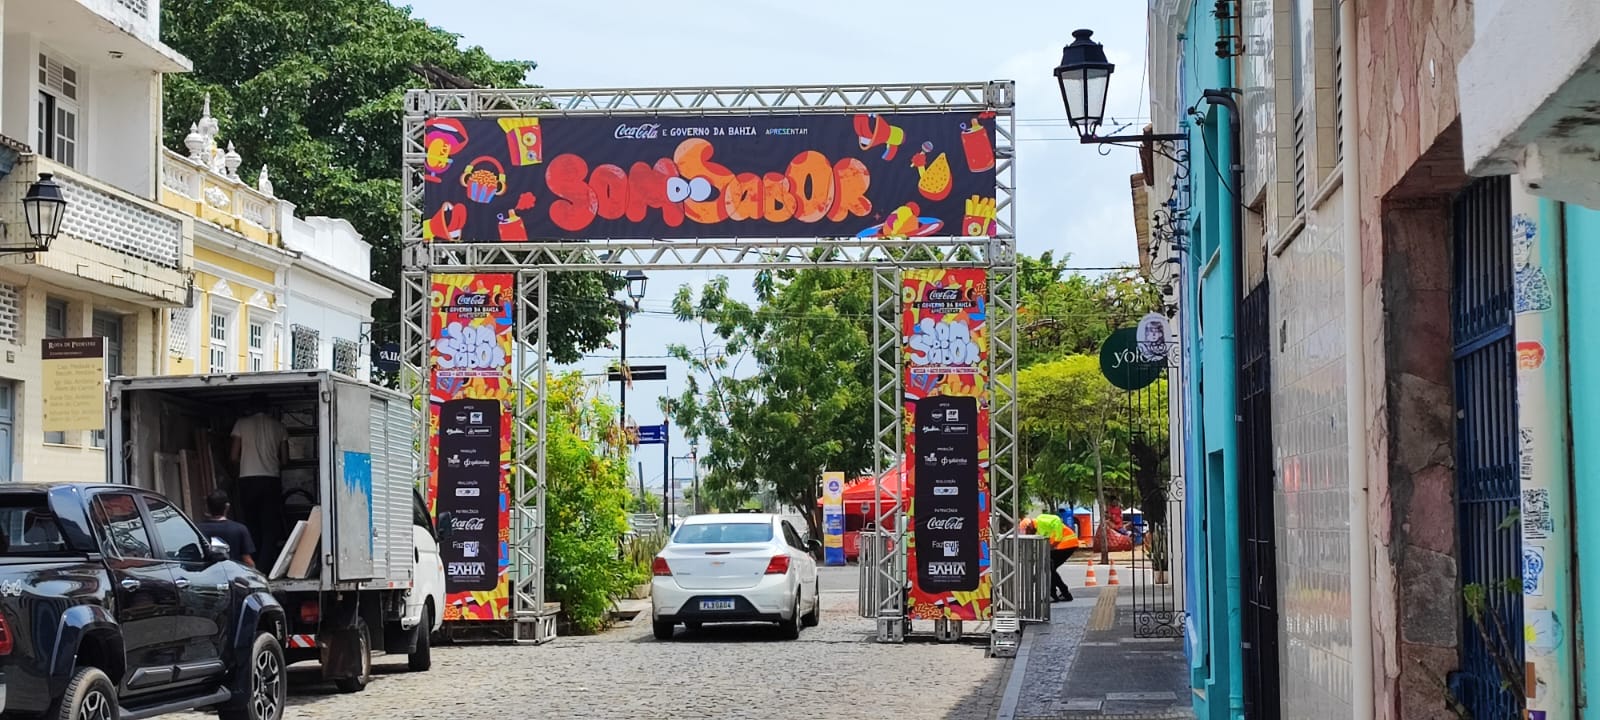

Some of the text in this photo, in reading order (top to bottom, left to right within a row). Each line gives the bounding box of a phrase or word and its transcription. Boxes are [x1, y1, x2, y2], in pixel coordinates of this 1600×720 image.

[662, 129, 667, 137] E
[670, 127, 710, 137] GOVERNO
[713, 127, 725, 136] DA
[728, 127, 757, 136] BAHIA
[765, 128, 808, 136] APRESENTAM
[448, 565, 486, 575] BAHIA
[928, 565, 966, 575] BAHIA
